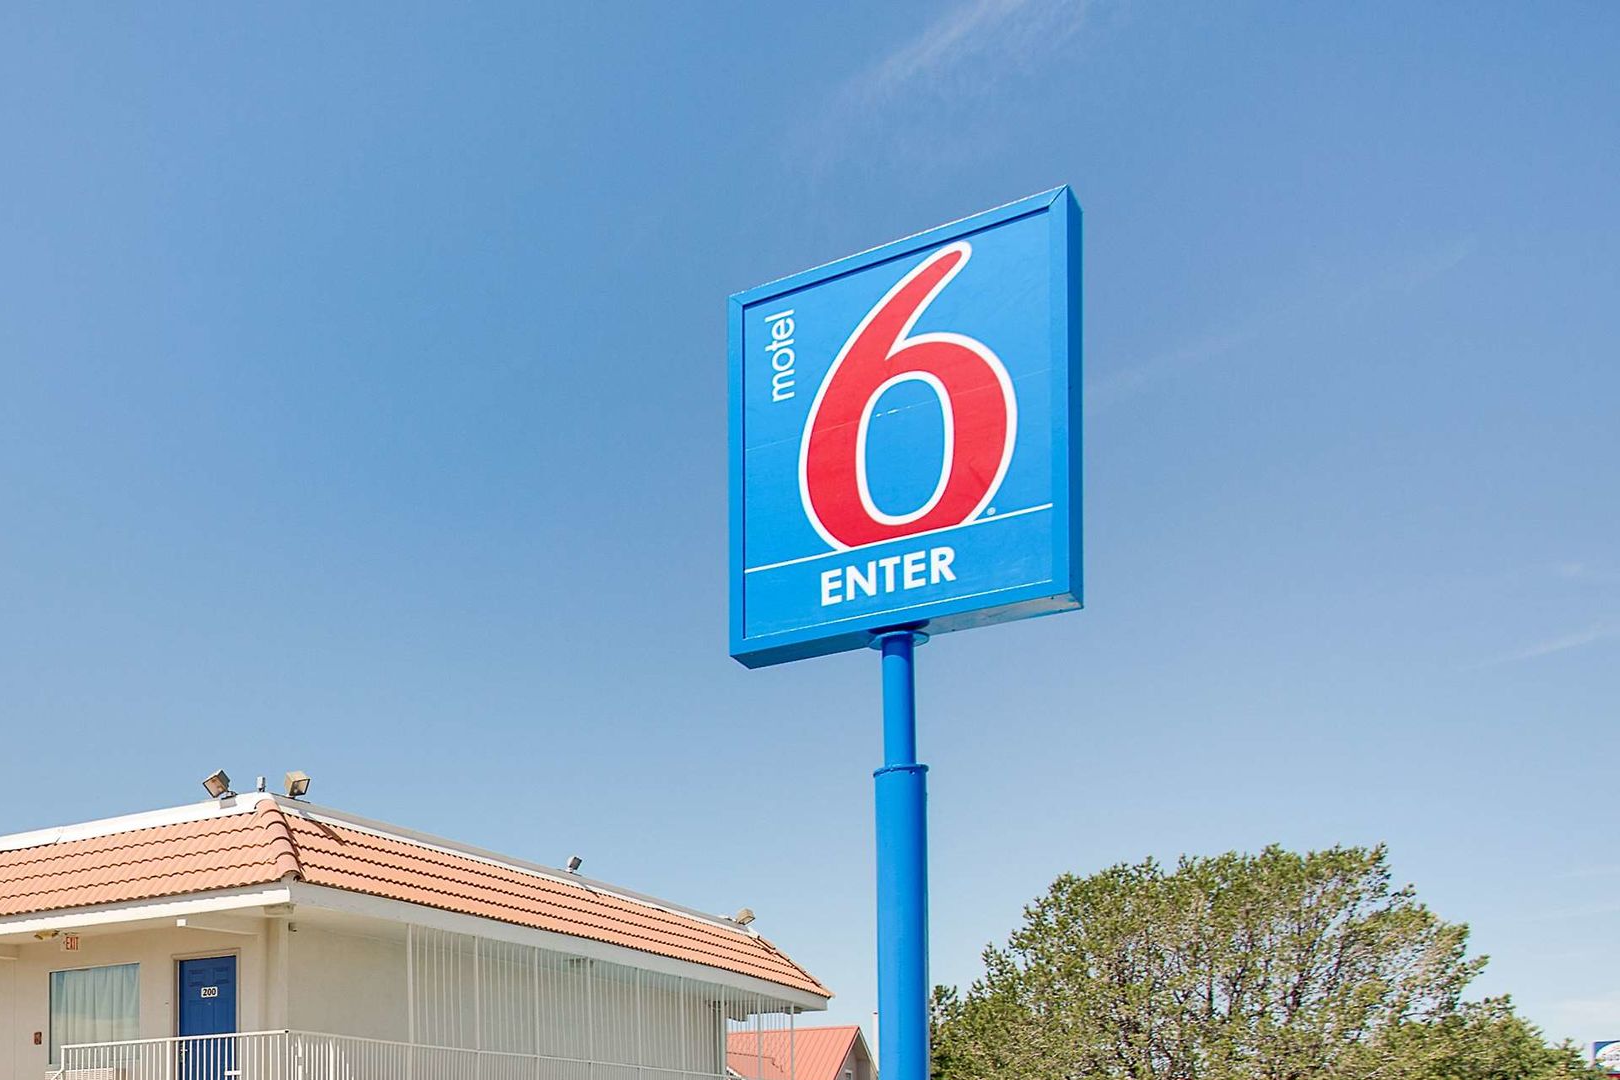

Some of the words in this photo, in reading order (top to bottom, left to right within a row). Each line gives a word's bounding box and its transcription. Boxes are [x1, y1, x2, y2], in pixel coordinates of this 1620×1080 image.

[764, 309, 796, 402] motel
[798, 241, 1017, 551] 6
[821, 546, 957, 607] ENTER
[202, 988, 217, 997] 200
